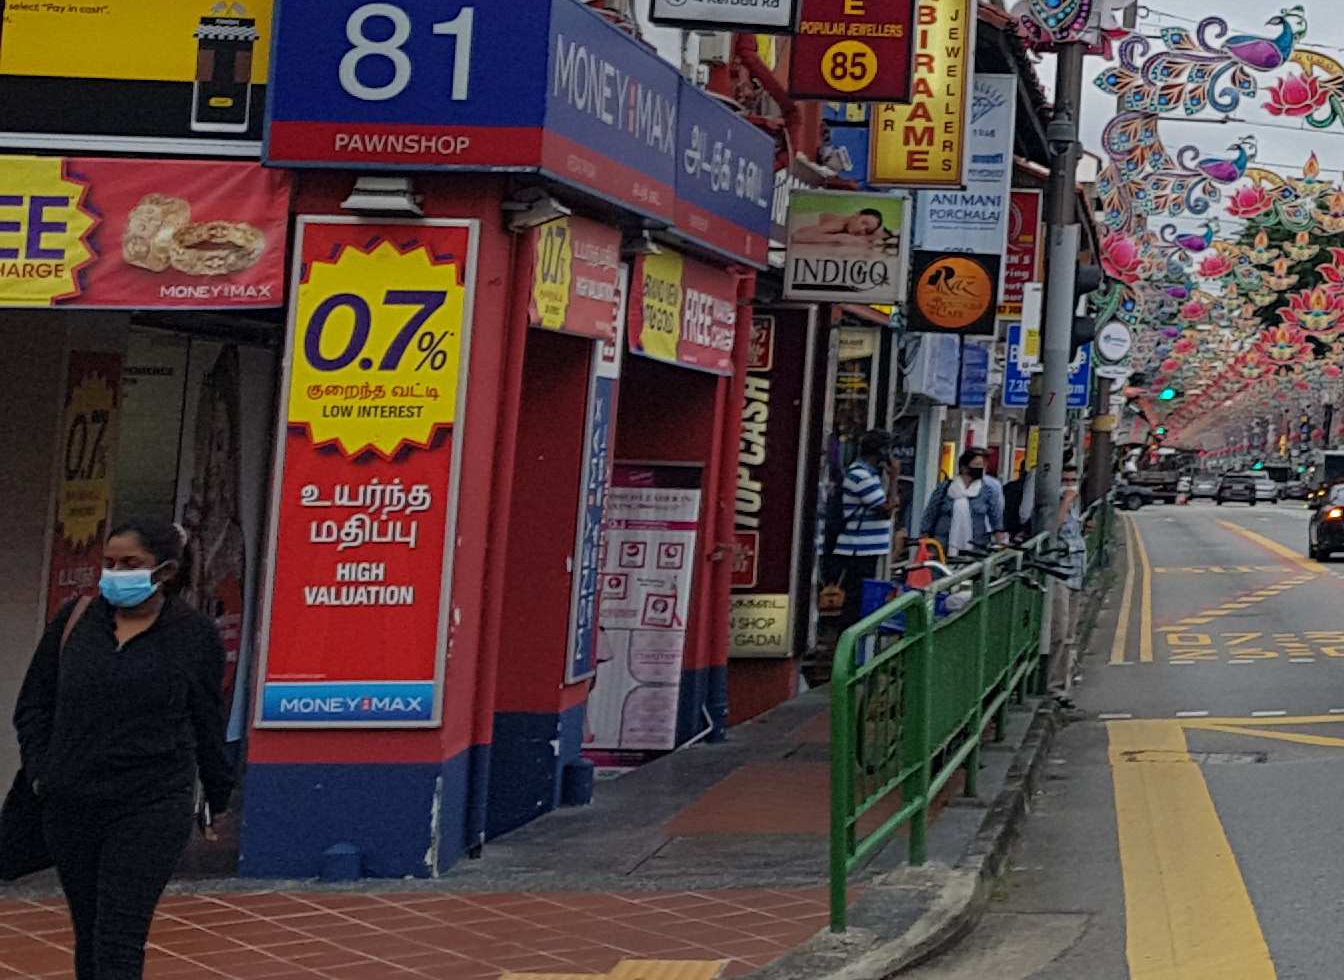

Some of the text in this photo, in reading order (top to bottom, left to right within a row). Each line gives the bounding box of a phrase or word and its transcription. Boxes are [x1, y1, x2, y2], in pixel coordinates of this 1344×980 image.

[800, 21, 904, 38] POPULAR JEWELLERS
[338, 1, 476, 102] 81
[830, 51, 868, 81] 85
[334, 133, 471, 155] PAWNSHOP
[0, 263, 64, 280] ARGE
[303, 289, 448, 374] 0.7%
[306, 380, 441, 401] குறைந்த வட்டி
[322, 404, 424, 419] LOW INTEREST
[738, 376, 770, 466] CASH
[309, 515, 418, 552] மதிப்பு
[336, 563, 385, 582] HIGH
[304, 584, 414, 607] VALUATION
[738, 616, 776, 631] SHOP
